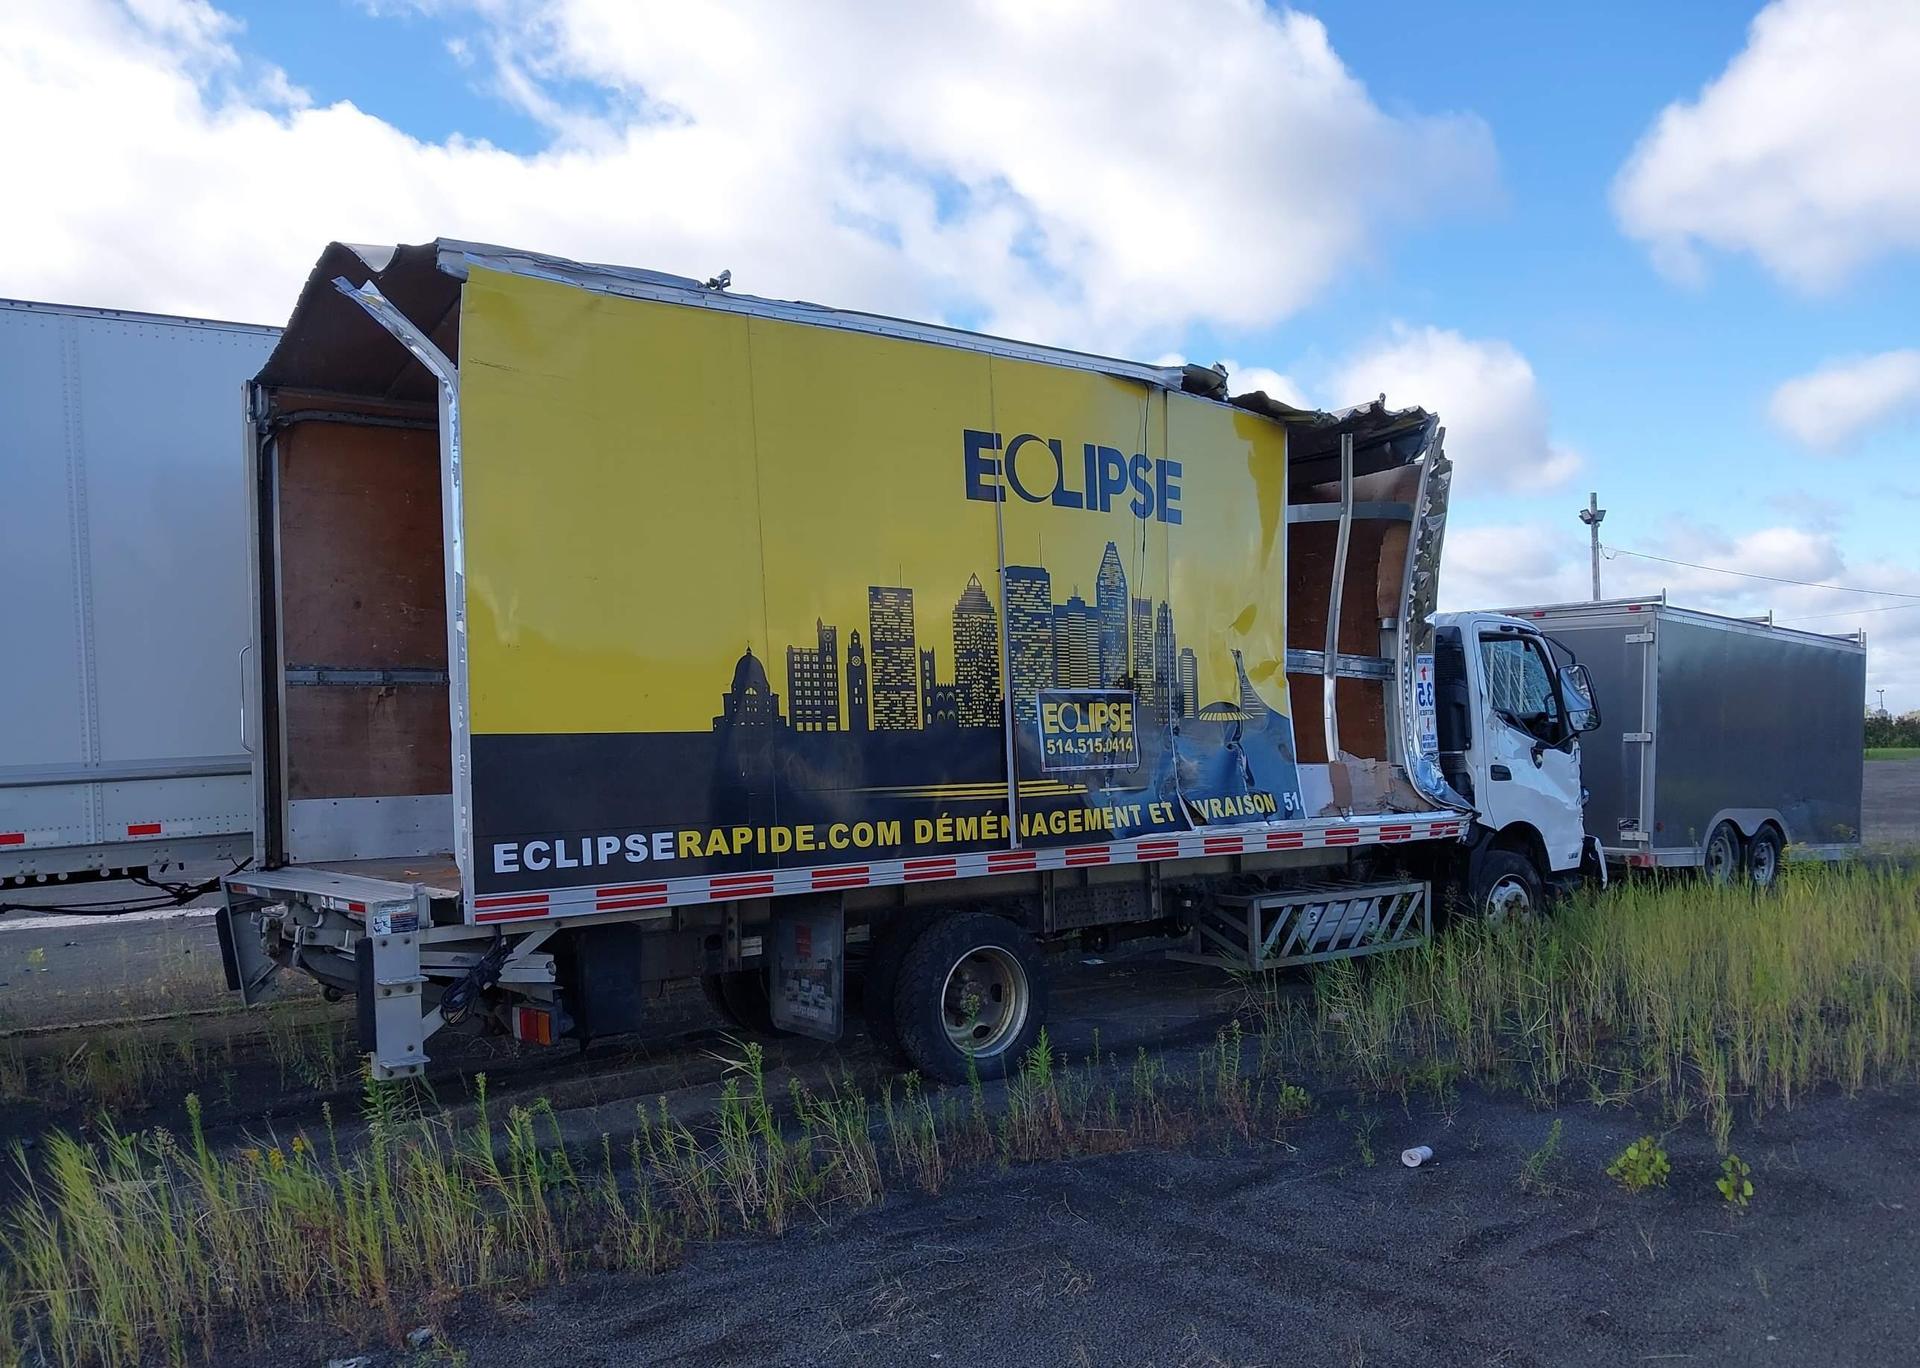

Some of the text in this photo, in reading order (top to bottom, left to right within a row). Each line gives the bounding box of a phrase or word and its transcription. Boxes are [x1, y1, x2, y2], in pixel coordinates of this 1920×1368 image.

[1047, 737, 1133, 755] 514.515.0414
[493, 820, 901, 873] ECLIPSERAPIDE.COM
[1149, 801, 1176, 824] ET
